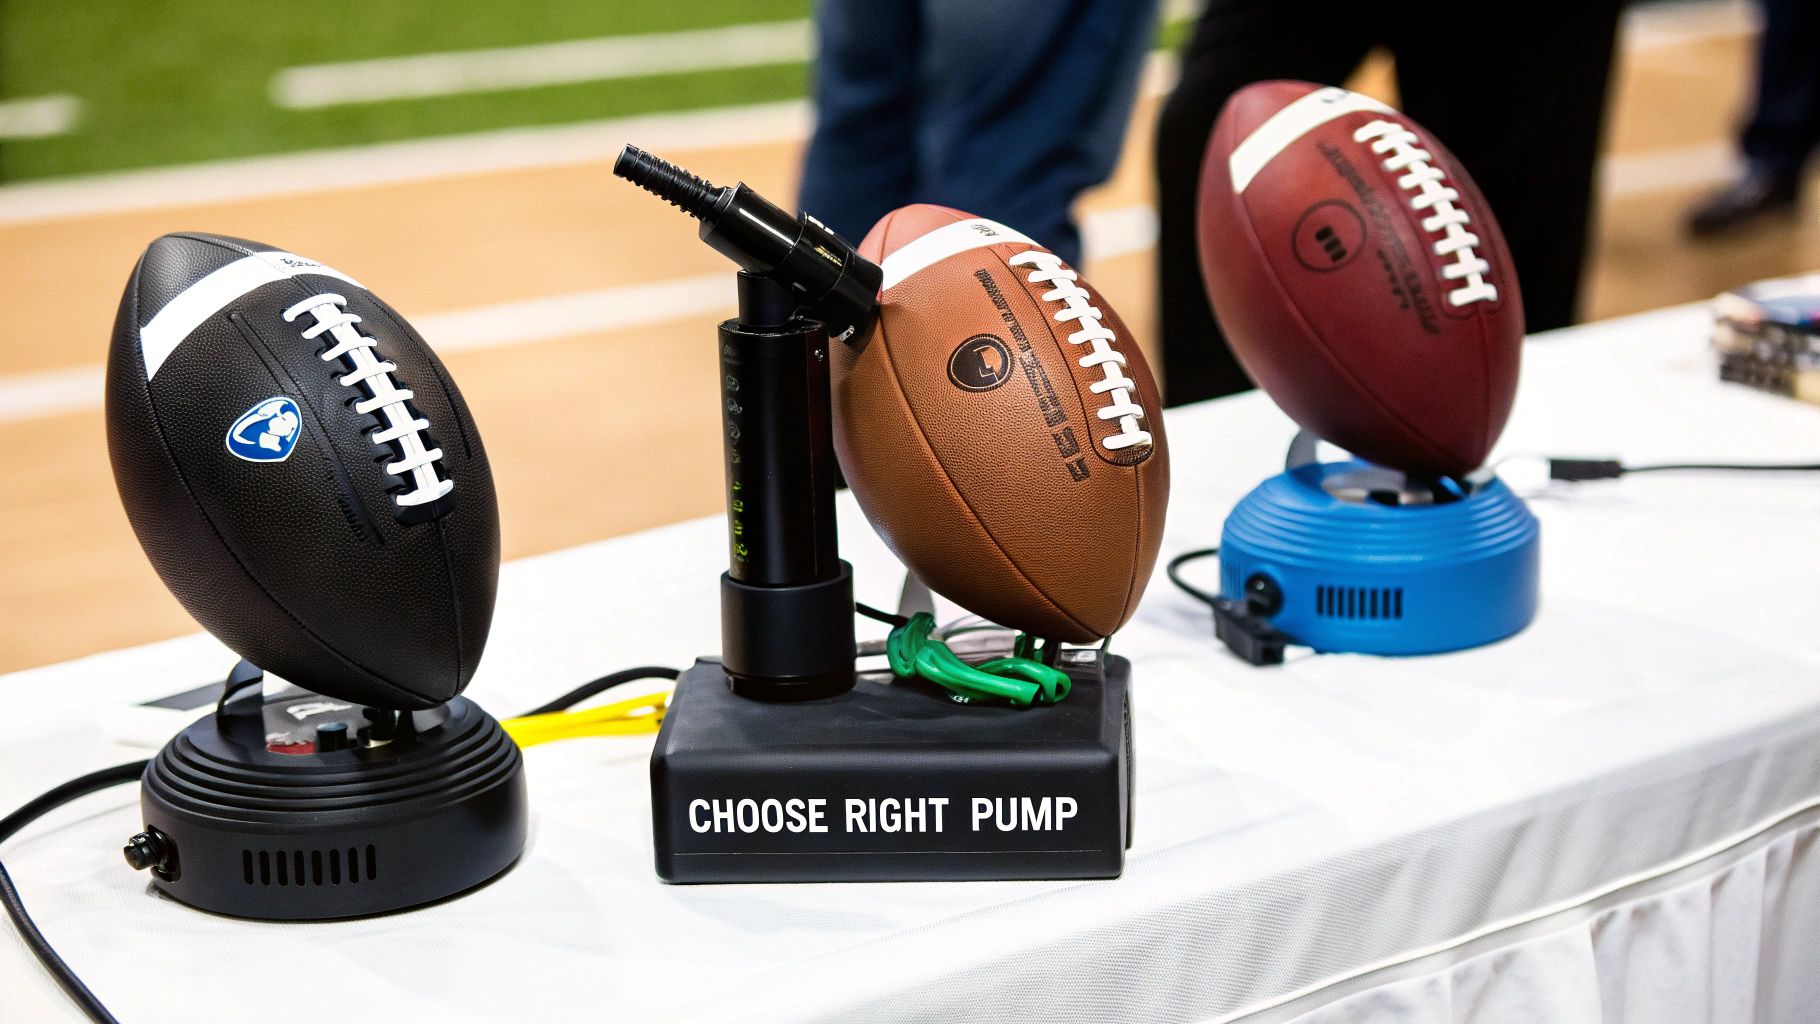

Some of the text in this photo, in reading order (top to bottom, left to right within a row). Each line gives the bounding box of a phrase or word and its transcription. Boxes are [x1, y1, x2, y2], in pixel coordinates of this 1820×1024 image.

[688, 796, 1078, 834] CHOOSE RIGHT PUMP
